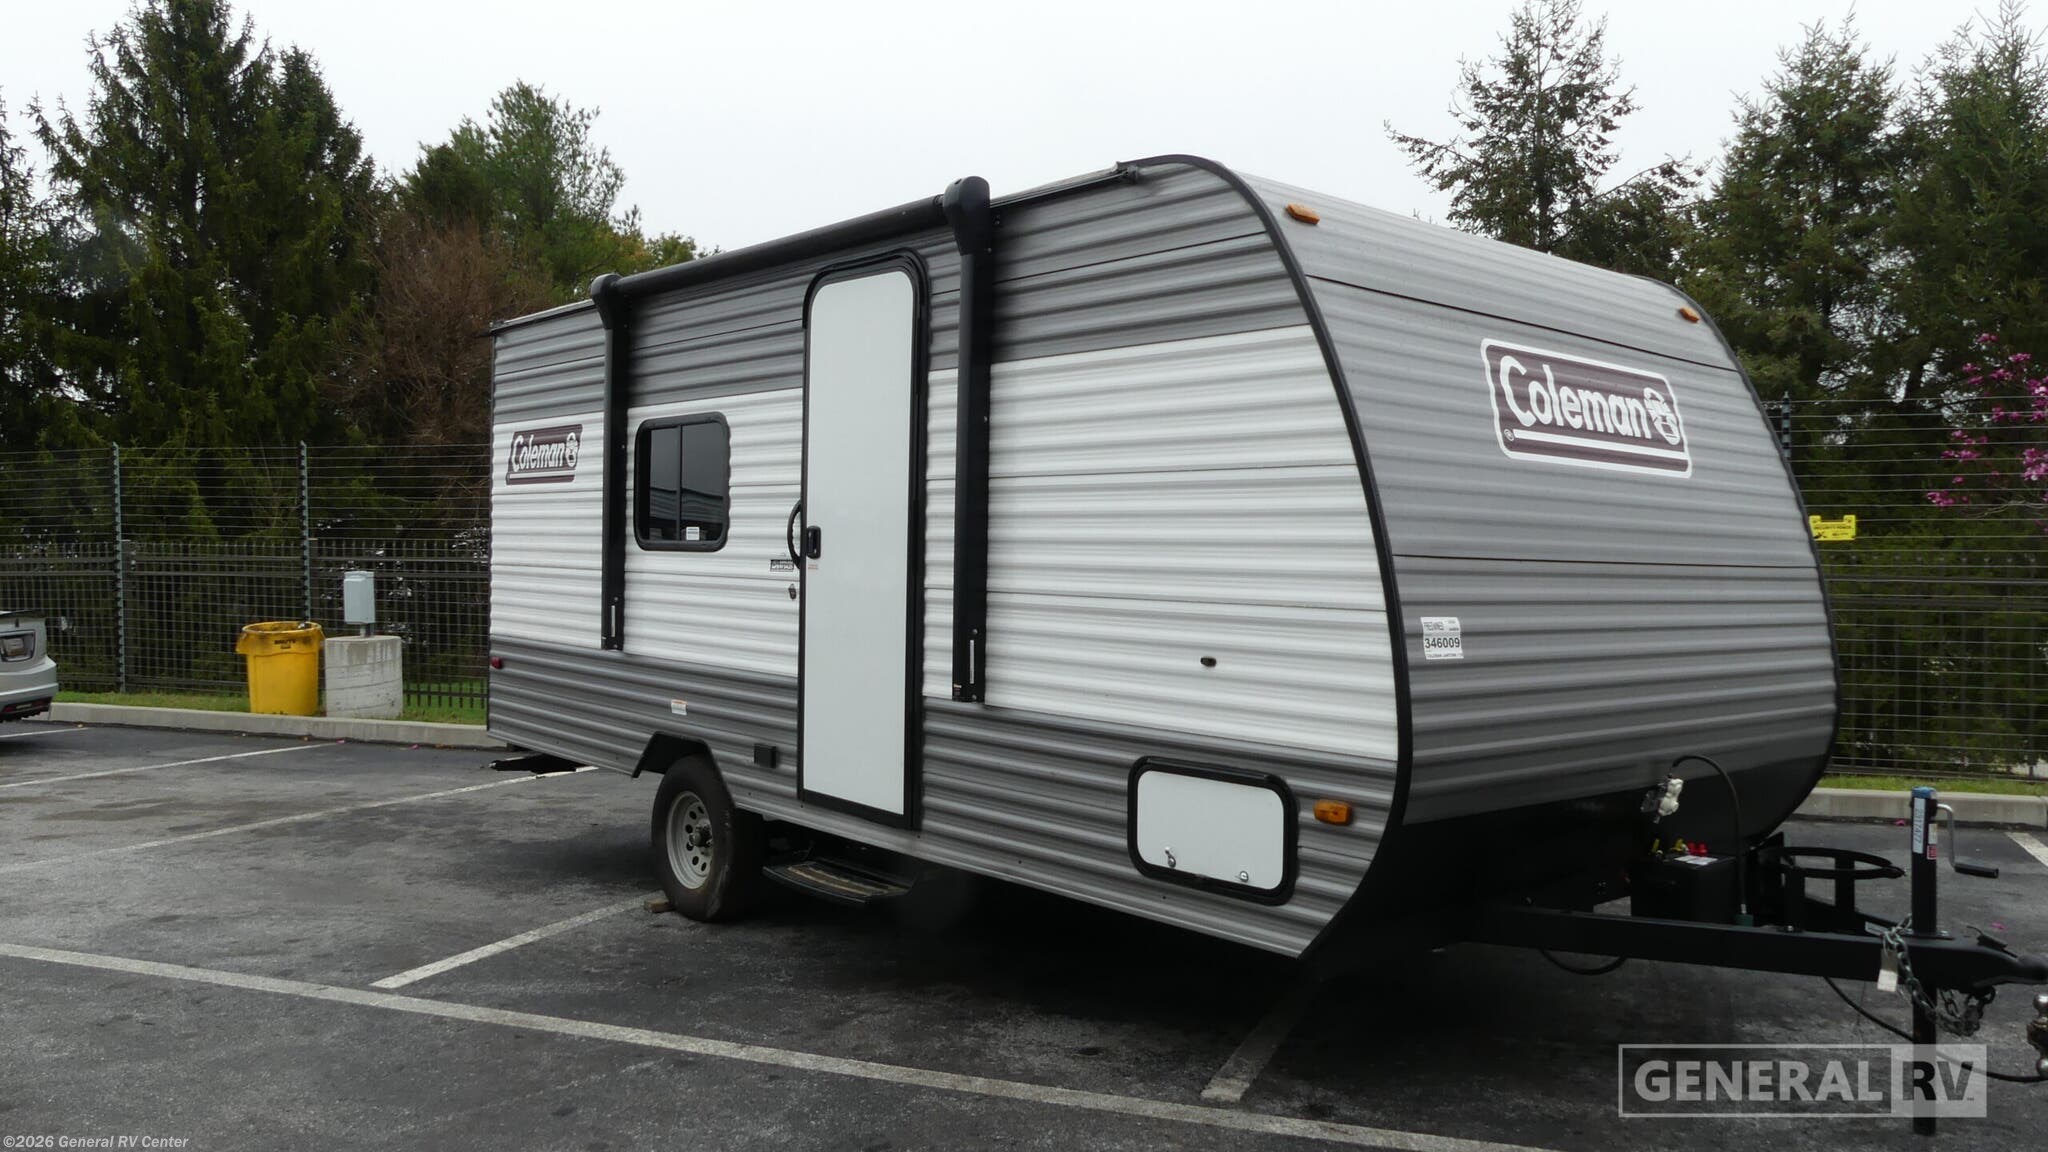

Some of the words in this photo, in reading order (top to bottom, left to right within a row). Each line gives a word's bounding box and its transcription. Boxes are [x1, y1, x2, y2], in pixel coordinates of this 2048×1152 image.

[1499, 355, 1652, 439] Coleman
[512, 433, 566, 472] Coleman
[1424, 637, 1460, 648] 346009
